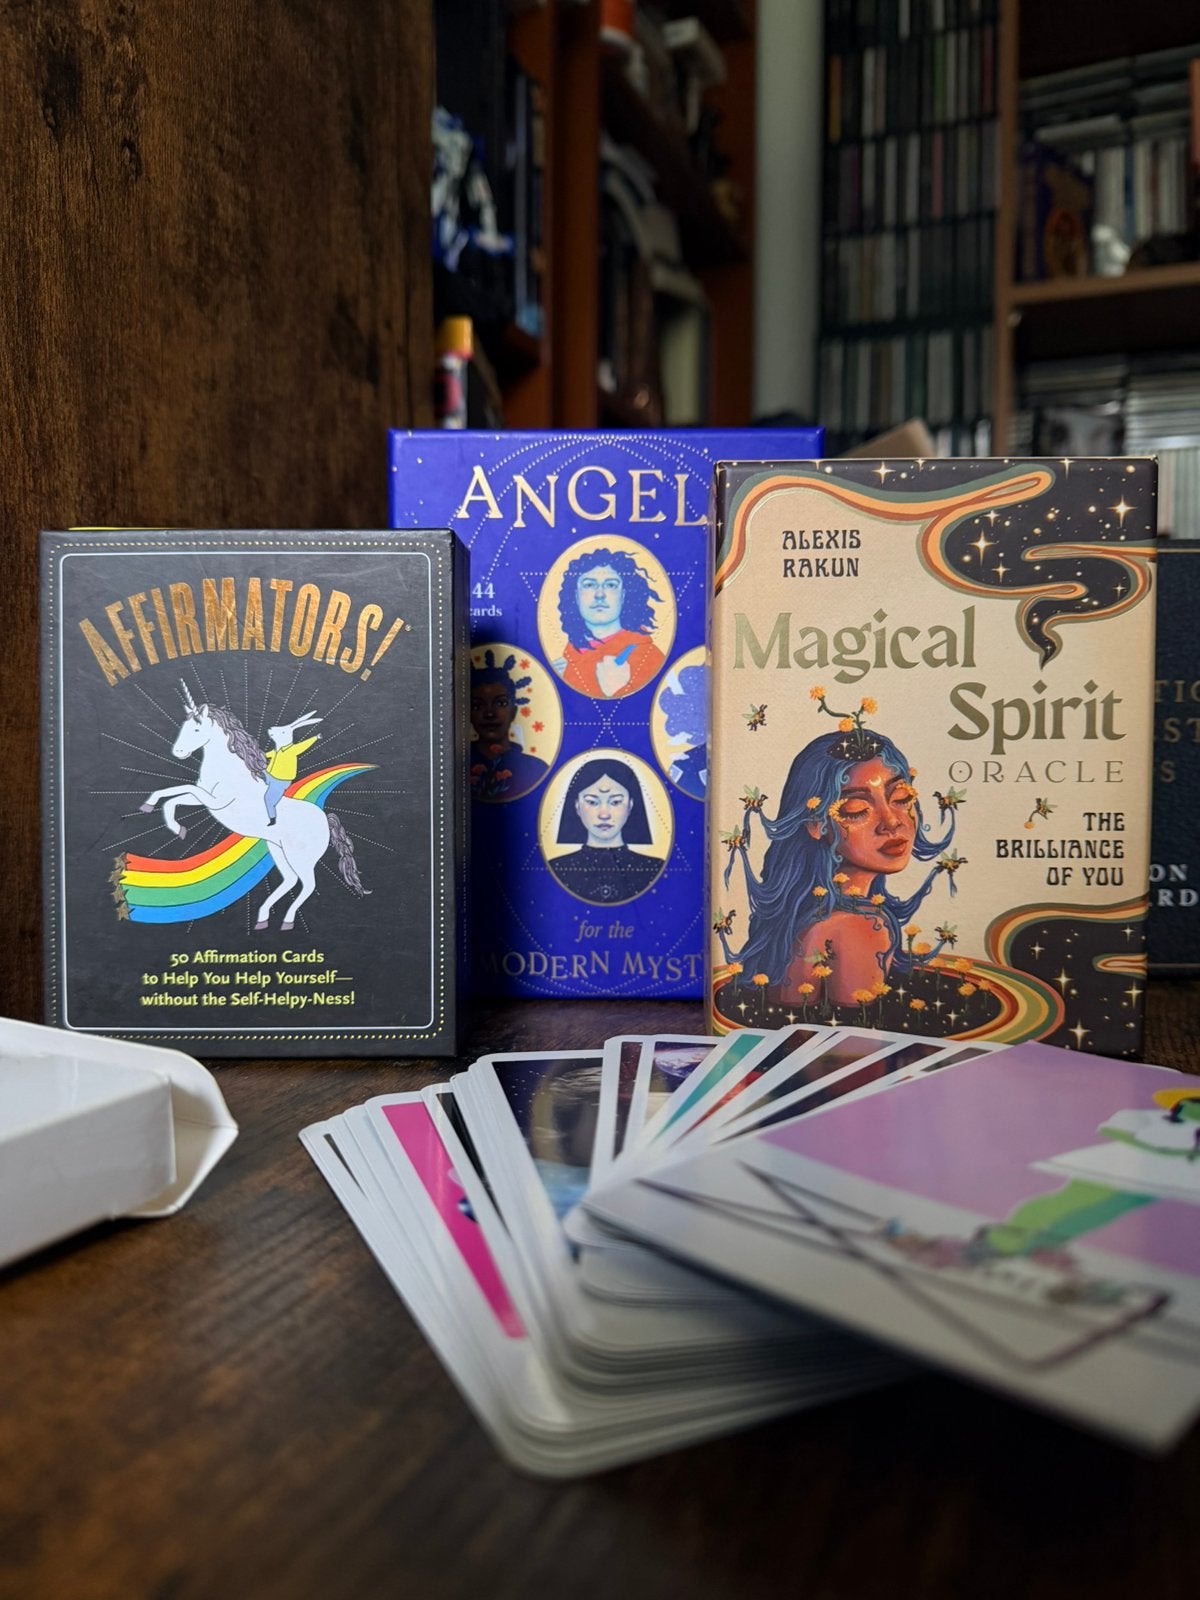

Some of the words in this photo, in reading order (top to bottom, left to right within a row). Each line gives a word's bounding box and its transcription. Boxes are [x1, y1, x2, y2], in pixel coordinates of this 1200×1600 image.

[456, 465, 708, 528] ANGEL
[782, 529, 861, 550] ALEXIS
[782, 557, 860, 578] RAKUN
[472, 582, 496, 599] 44
[78, 577, 405, 687] AFFIRMATORS!
[732, 604, 977, 685] Magical
[947, 679, 1128, 755] Spirit
[1153, 718, 1200, 743] ST
[948, 760, 1124, 784] ORACLE
[1082, 811, 1125, 832] THE
[995, 839, 1125, 859] BRILLIANCE
[1046, 867, 1073, 886] OF
[1082, 867, 1125, 886] YOU
[1148, 888, 1200, 908] RD
[575, 919, 602, 943] for
[607, 920, 635, 939] the
[170, 953, 190, 967] 50
[193, 949, 277, 964] Affirmation
[282, 949, 325, 963] Cards
[141, 972, 159, 985] to
[162, 971, 199, 988] Help
[202, 972, 230, 985] You
[234, 970, 271, 988] Help
[140, 992, 199, 1006] without
[201, 992, 227, 1006] the
[229, 991, 355, 1009] Self-Helpy-Ness!
